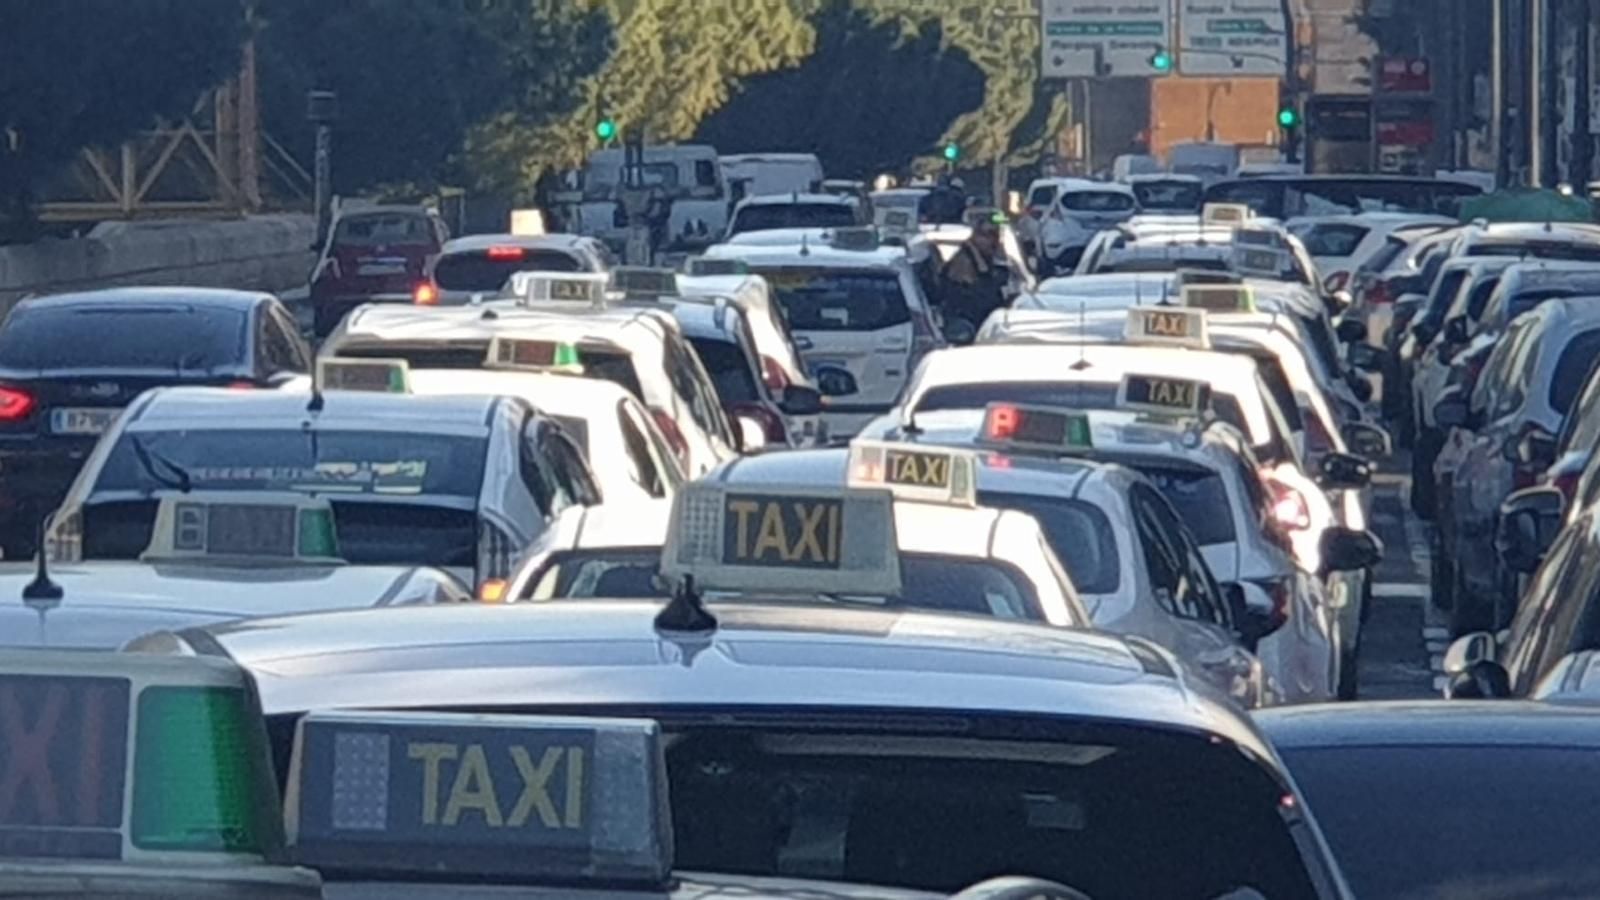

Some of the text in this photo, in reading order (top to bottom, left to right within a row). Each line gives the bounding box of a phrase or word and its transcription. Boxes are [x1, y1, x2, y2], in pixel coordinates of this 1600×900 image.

[1145, 312, 1188, 336] TAXI
[1147, 380, 1195, 407] TAXI
[888, 453, 948, 484] TAXI
[728, 501, 839, 563] TAXI
[407, 742, 584, 829] TAXI
